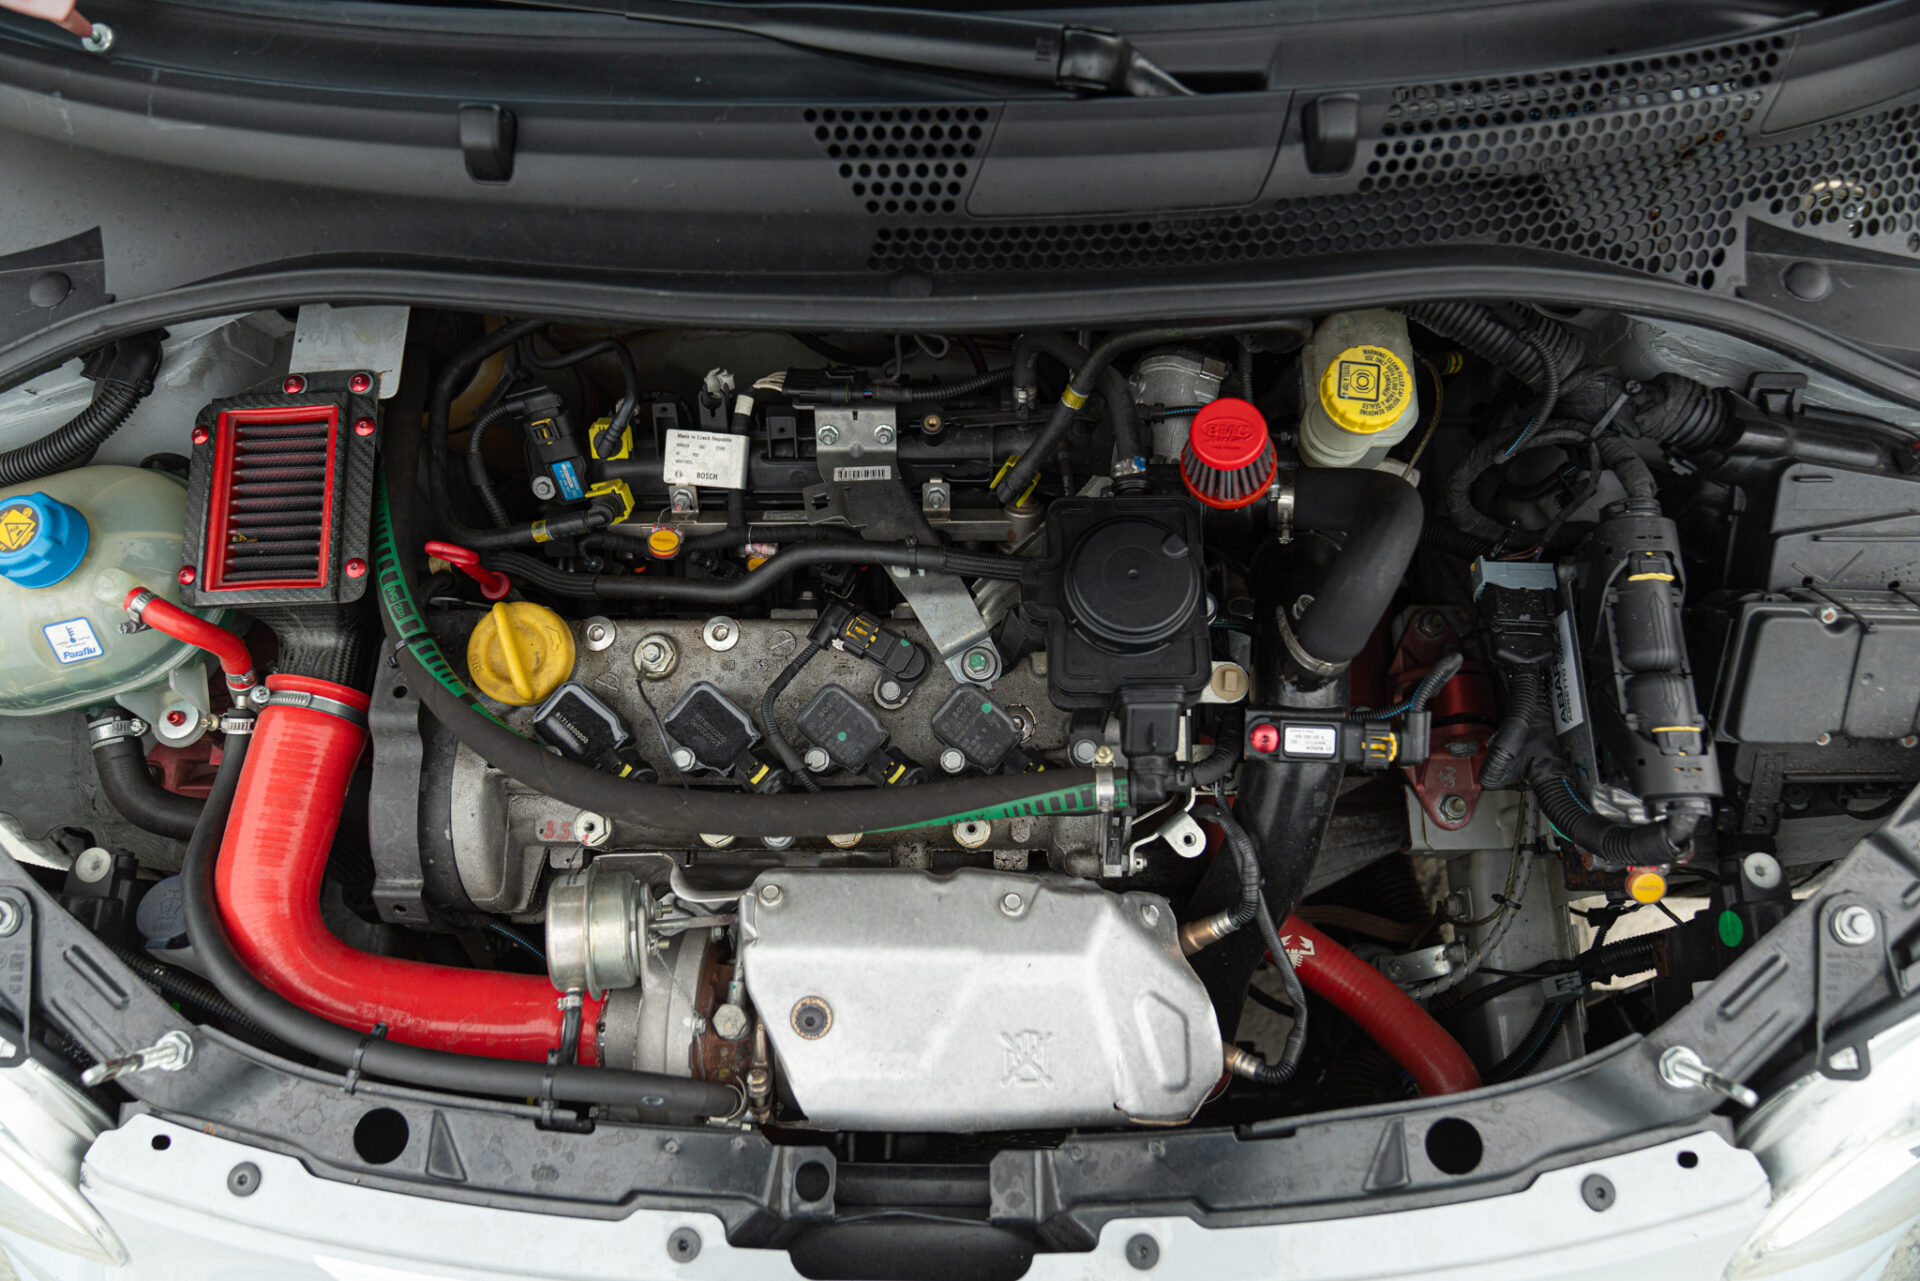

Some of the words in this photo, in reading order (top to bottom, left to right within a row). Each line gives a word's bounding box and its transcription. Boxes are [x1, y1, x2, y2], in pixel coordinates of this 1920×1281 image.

[1362, 350, 1386, 359] WARNING!
[1386, 356, 1400, 371] CLEAN
[1386, 398, 1401, 412] BEFORE
[696, 472, 718, 480] BOSCH
[63, 646, 96, 660] Paraflu
